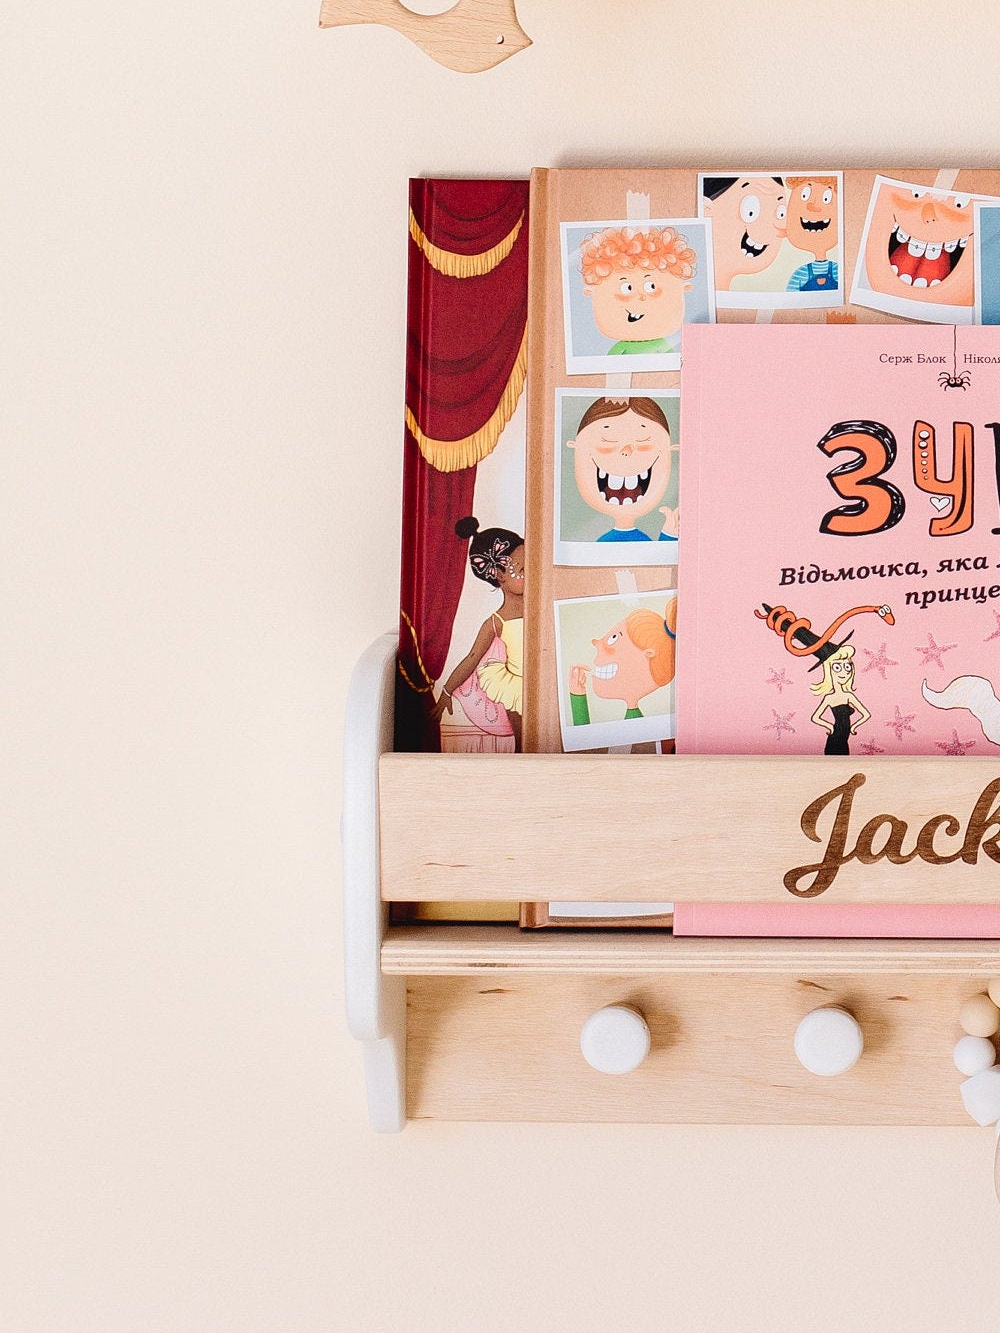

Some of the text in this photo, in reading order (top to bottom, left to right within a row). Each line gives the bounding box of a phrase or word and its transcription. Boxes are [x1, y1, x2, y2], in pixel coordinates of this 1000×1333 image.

[879, 352, 947, 366] Серж Блок
[778, 558, 929, 588] Відьмочка,
[936, 553, 990, 574] яка
